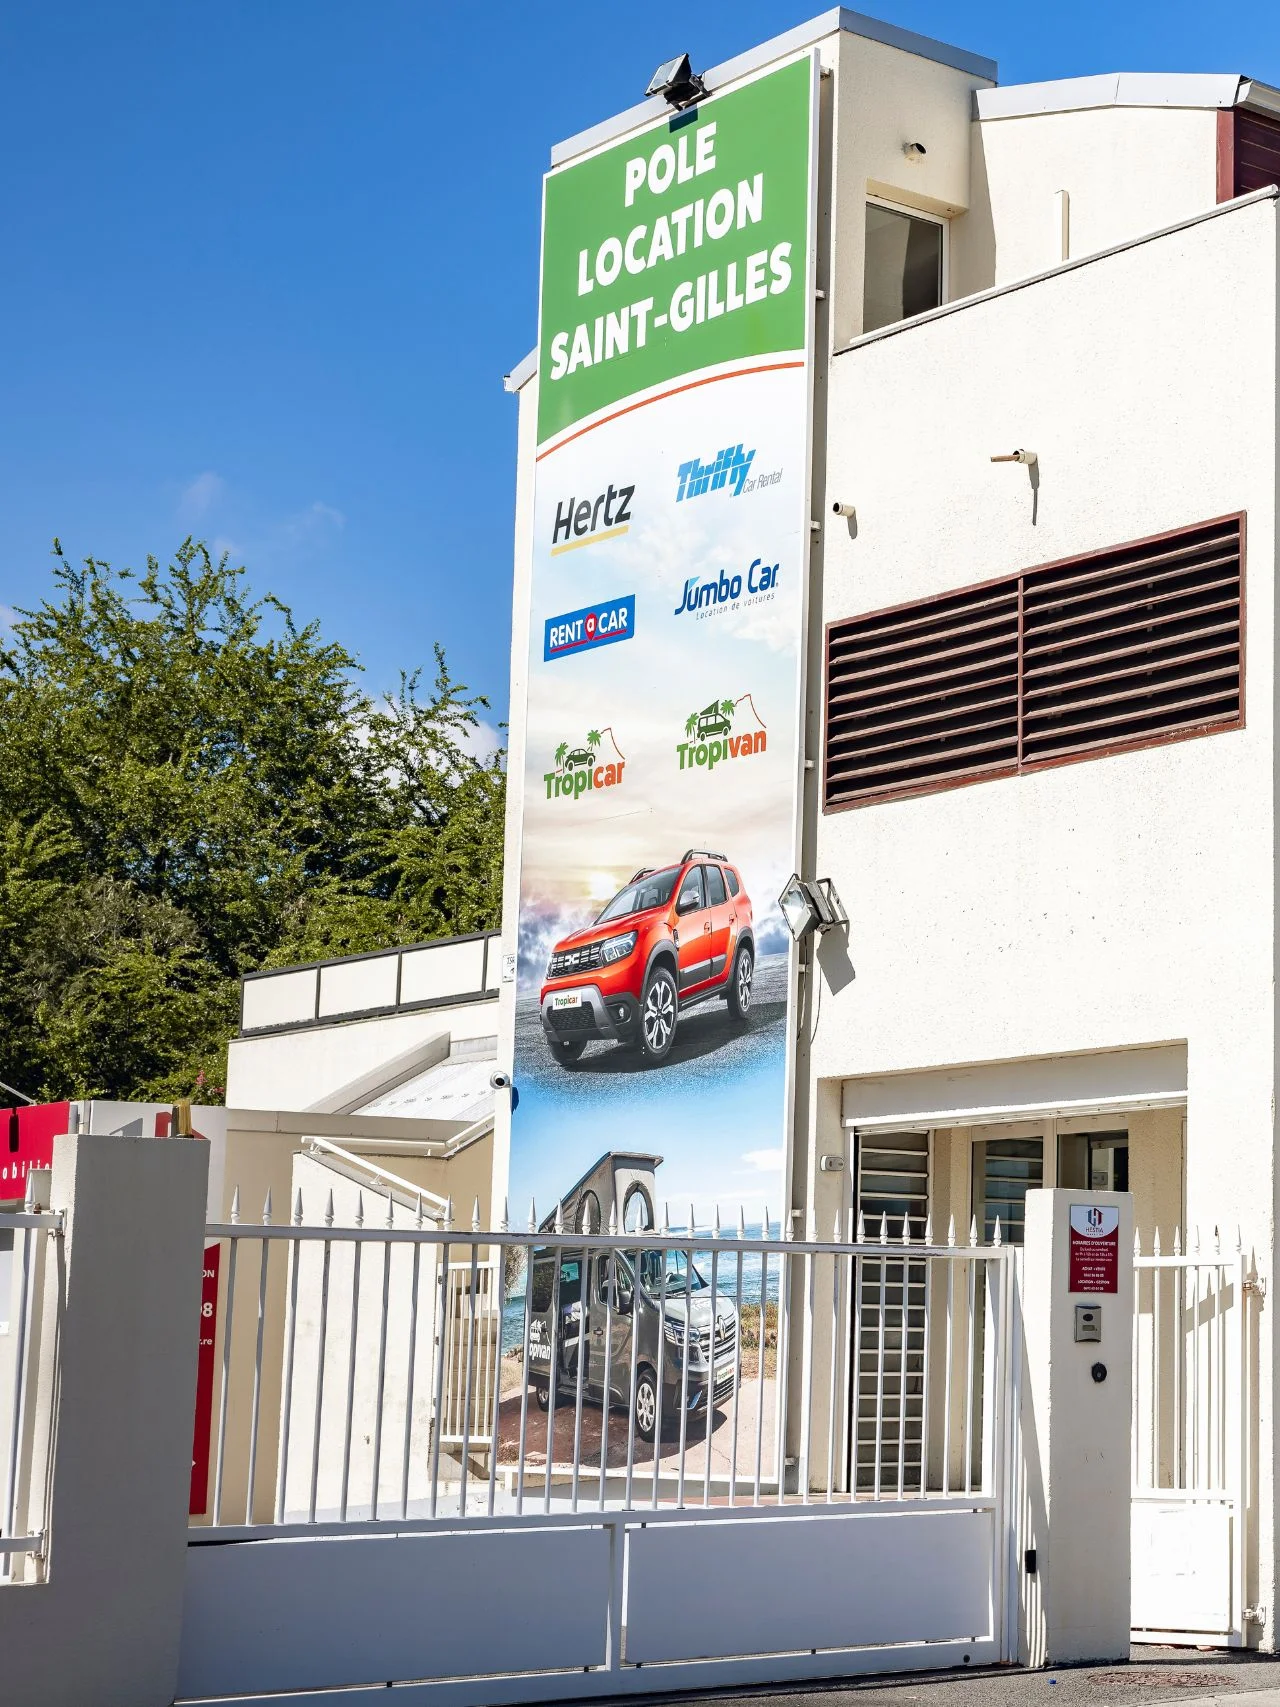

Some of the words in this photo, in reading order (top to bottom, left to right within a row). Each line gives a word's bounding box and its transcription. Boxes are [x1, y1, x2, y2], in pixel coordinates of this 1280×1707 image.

[625, 121, 716, 207] POLE
[577, 172, 764, 297] LOCATION
[550, 242, 792, 380] SAINT-GILLES
[676, 443, 756, 503] Thrifty
[743, 478, 758, 494] Car
[757, 467, 783, 491] Rental
[552, 484, 636, 544] Hertz
[674, 568, 742, 616] Jumbo
[748, 558, 780, 594] Car
[696, 605, 728, 621] Location
[731, 601, 740, 611] de
[744, 592, 775, 606] voitures
[550, 618, 583, 648] RENT
[598, 607, 628, 633] CAR
[676, 729, 767, 770] Tropivan
[543, 760, 625, 800] Tropicar
[555, 995, 578, 1006] Tropicar
